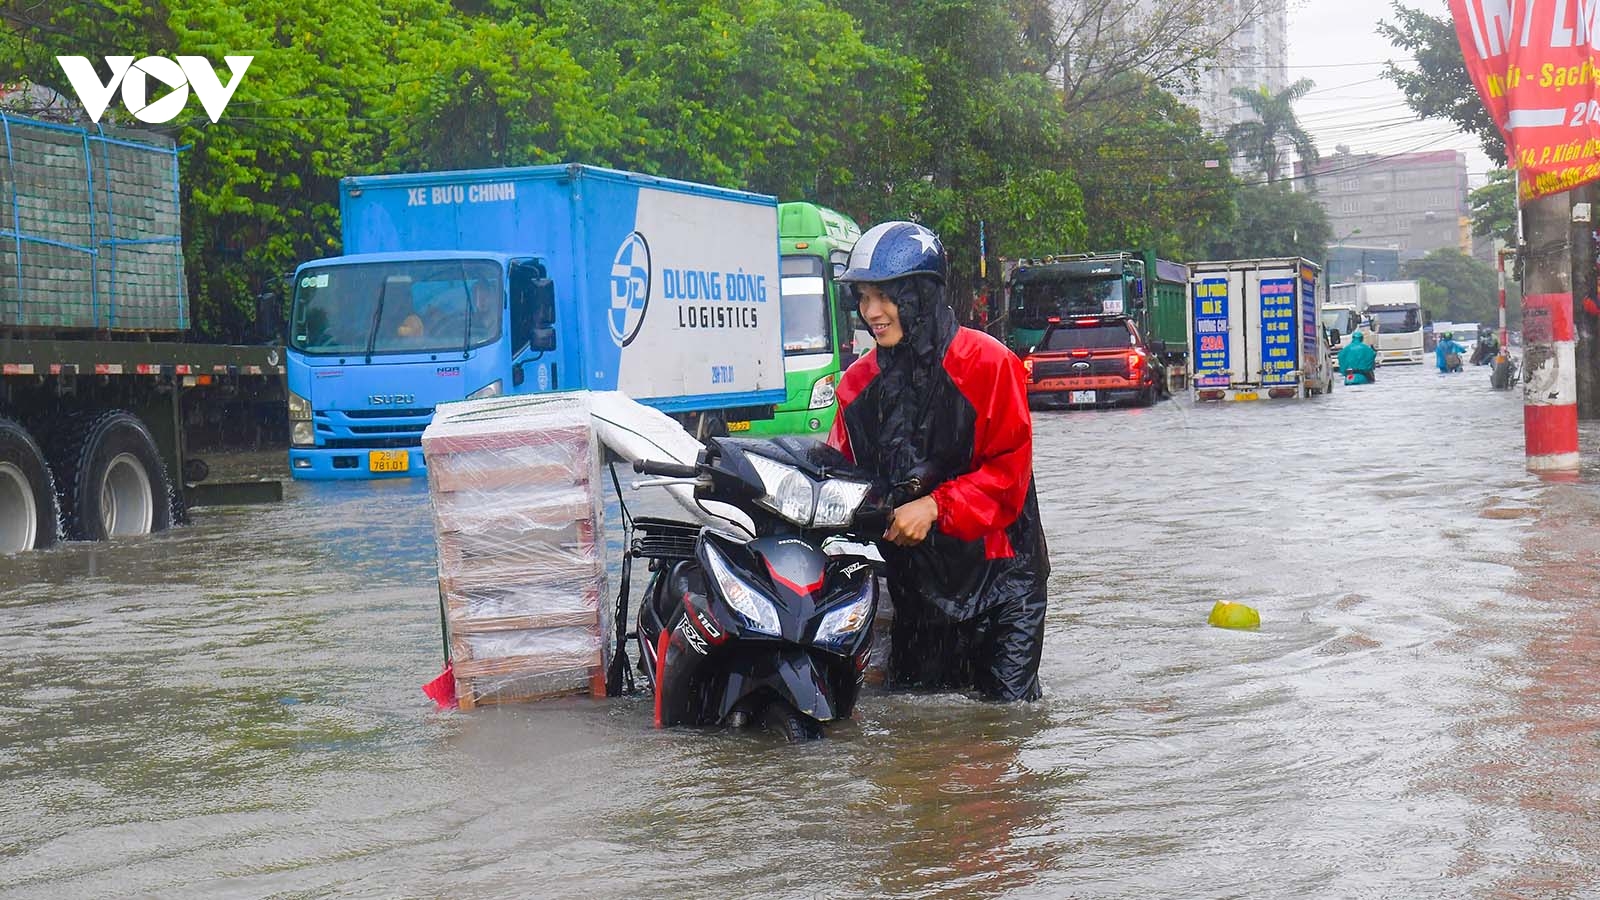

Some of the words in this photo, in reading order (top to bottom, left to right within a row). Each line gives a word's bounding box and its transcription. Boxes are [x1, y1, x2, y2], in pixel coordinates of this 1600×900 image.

[407, 187, 427, 206] XE
[725, 266, 767, 302] ĐÔNG
[678, 305, 758, 328] LOGISTICS
[1200, 336, 1224, 351] 29A
[436, 366, 460, 374] NQR
[367, 394, 415, 406] ISUZU
[374, 461, 404, 471] 781.01
[777, 538, 814, 551] HONDA
